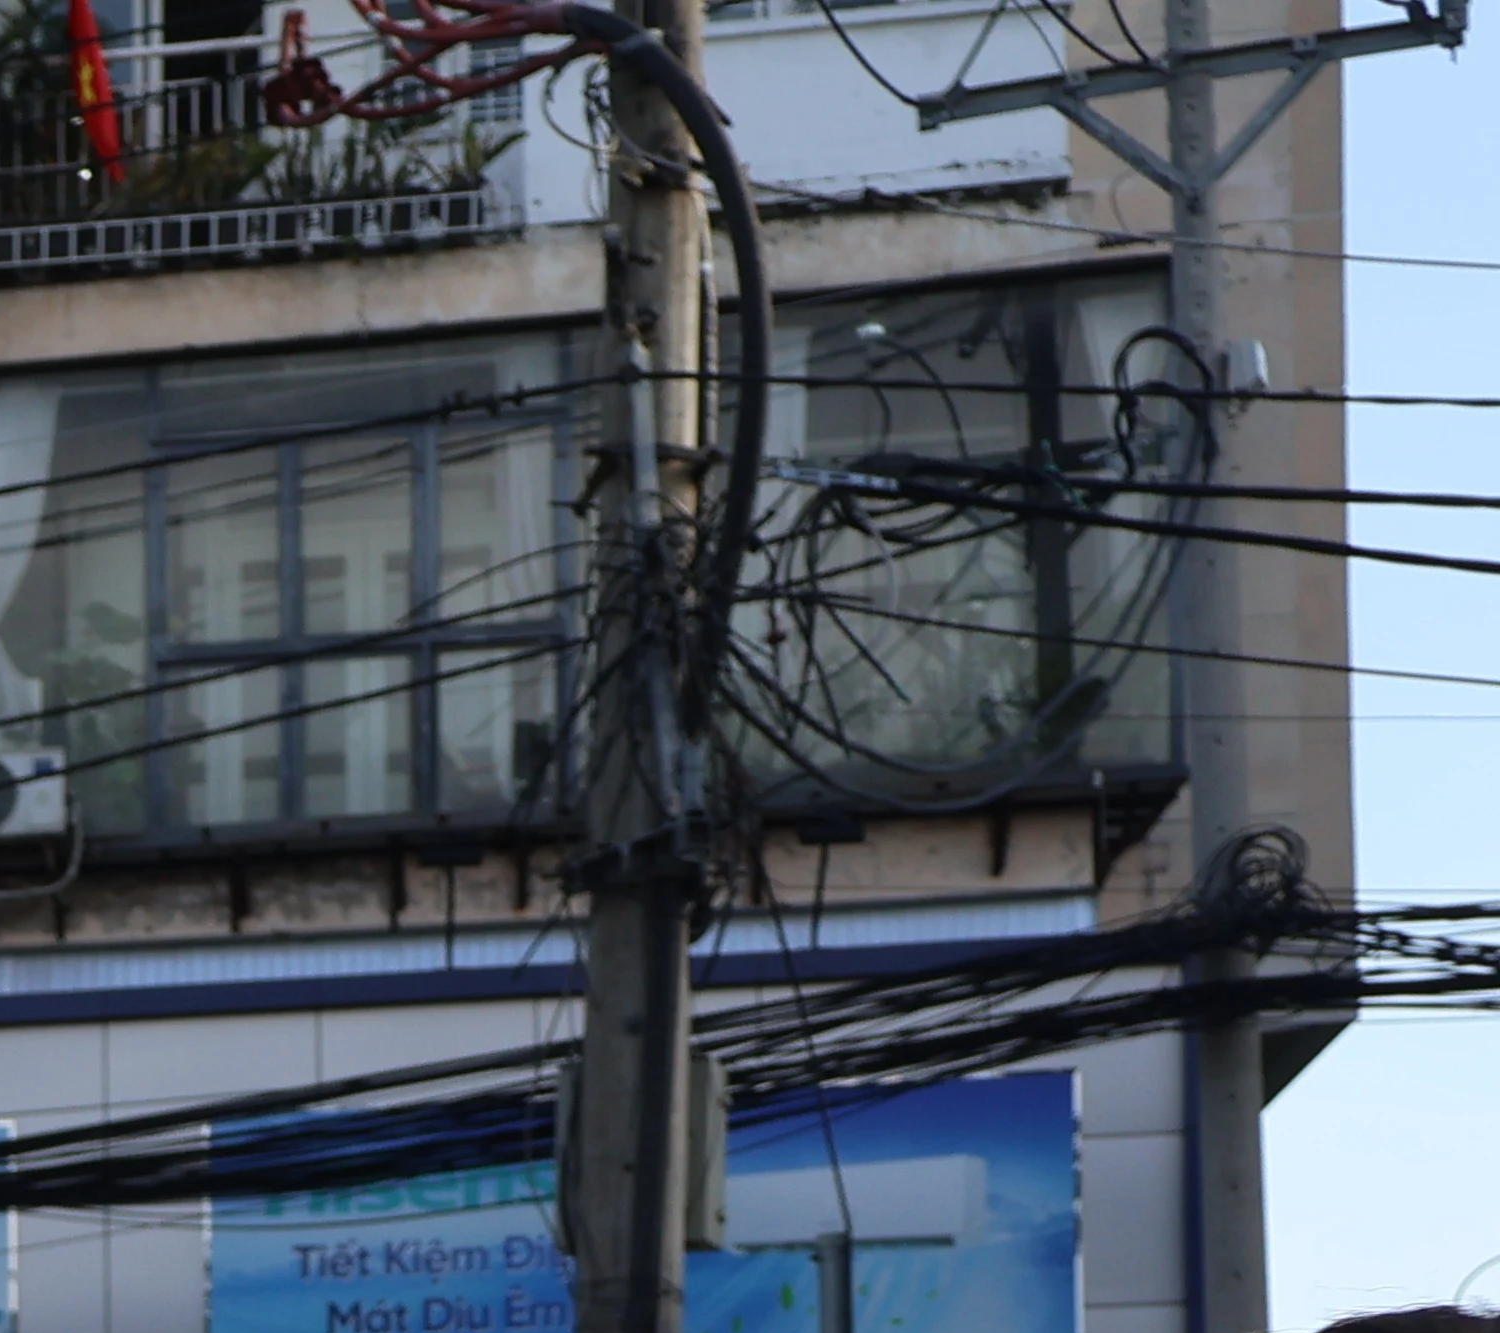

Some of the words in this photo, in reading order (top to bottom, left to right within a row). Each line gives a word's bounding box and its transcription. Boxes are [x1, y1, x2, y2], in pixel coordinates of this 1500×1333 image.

[293, 1237, 372, 1279] Tiết
[384, 1238, 489, 1284] Kiệm
[504, 1283, 568, 1328] Êm
